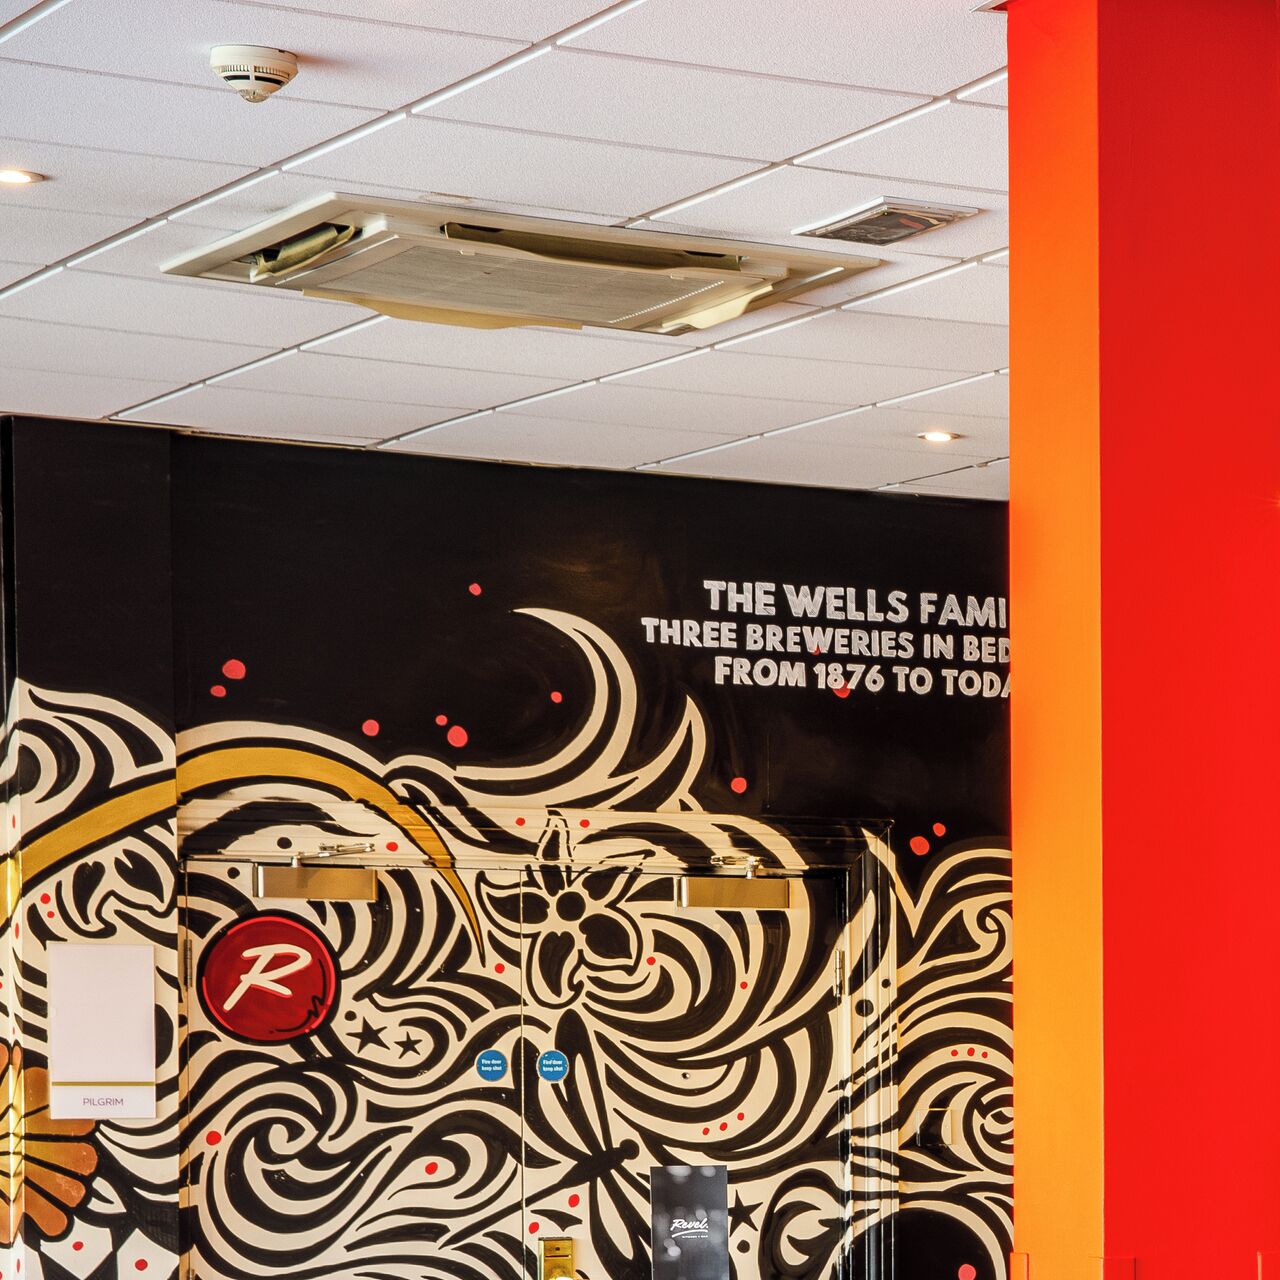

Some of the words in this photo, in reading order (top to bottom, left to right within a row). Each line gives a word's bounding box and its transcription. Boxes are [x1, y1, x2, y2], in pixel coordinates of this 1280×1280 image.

[703, 580, 776, 616] THE
[783, 584, 907, 623] WELLS
[641, 617, 737, 649] THREE
[746, 624, 914, 659] BREWERIES
[923, 634, 953, 660] IN
[714, 656, 806, 688] FROM
[813, 664, 883, 692] 1876
[893, 667, 932, 695] TO
[222, 943, 313, 1013] R
[82, 1097, 124, 1107] PILGRIM
[670, 1217, 709, 1231] Revel.
